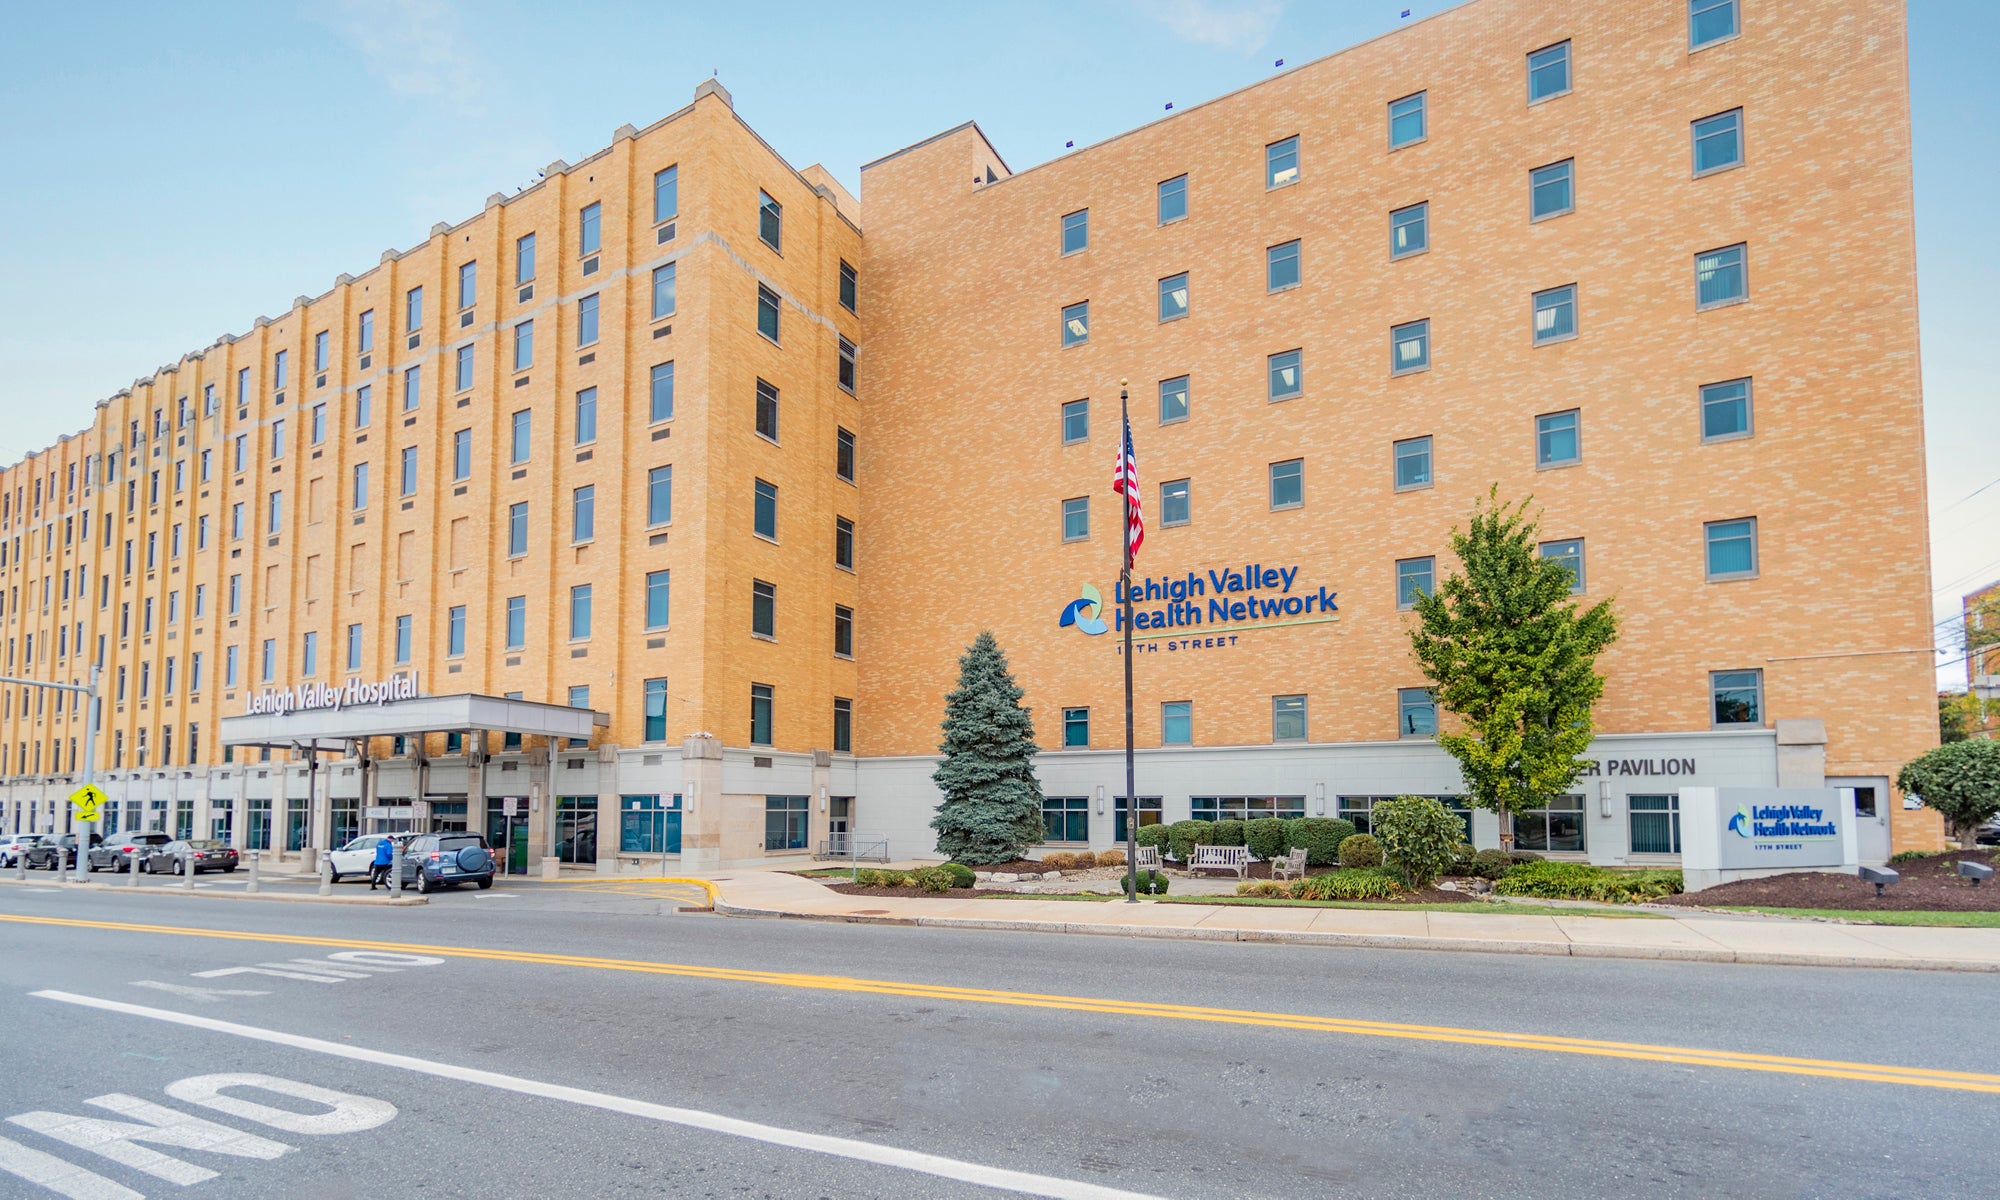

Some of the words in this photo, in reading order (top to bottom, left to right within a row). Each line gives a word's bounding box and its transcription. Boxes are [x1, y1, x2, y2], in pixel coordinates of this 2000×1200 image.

[1115, 572, 1204, 603] Lehigh
[1208, 563, 1298, 592] Valley
[1115, 601, 1202, 632] Health
[1209, 586, 1339, 622] Network
[1116, 643, 1158, 655] 1TH
[1168, 636, 1239, 651] STREET
[246, 686, 295, 716] Lehigh
[297, 682, 346, 711] Valley
[346, 670, 419, 706] Hospital
[1607, 758, 1696, 776] PAVILION
[1752, 805, 1790, 823] Lehigh
[1790, 805, 1823, 822] Valley
[1753, 821, 1790, 836] Health
[1791, 821, 1836, 836] Network
[127, 951, 446, 1002] ONLY
